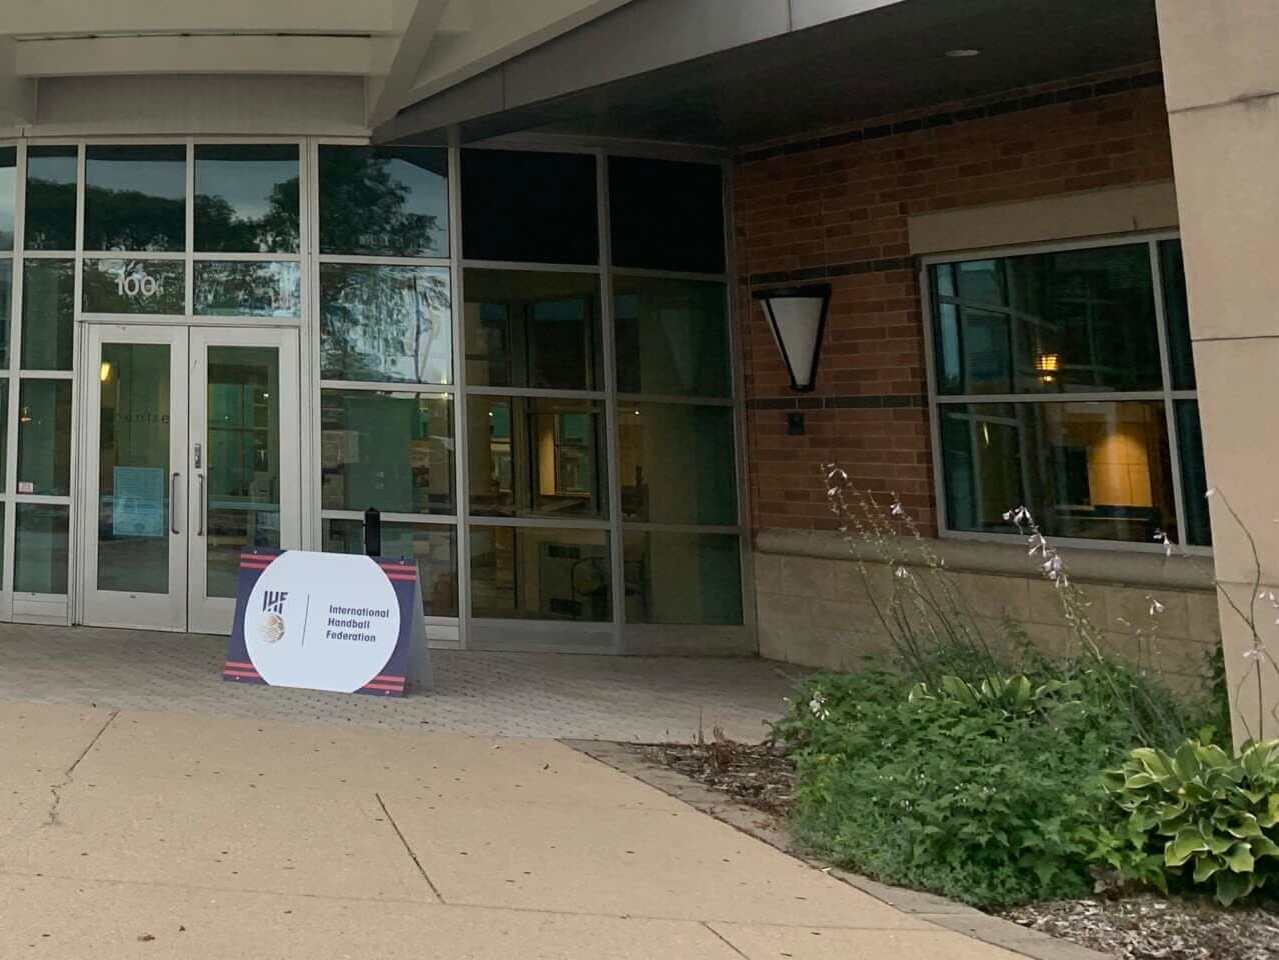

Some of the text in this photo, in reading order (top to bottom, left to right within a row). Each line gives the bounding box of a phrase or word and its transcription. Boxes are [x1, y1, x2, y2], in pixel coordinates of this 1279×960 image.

[114, 275, 156, 296] 100
[262, 590, 289, 615] IHF
[329, 604, 390, 619] International
[327, 617, 371, 630] Handball
[326, 629, 377, 644] Federation
